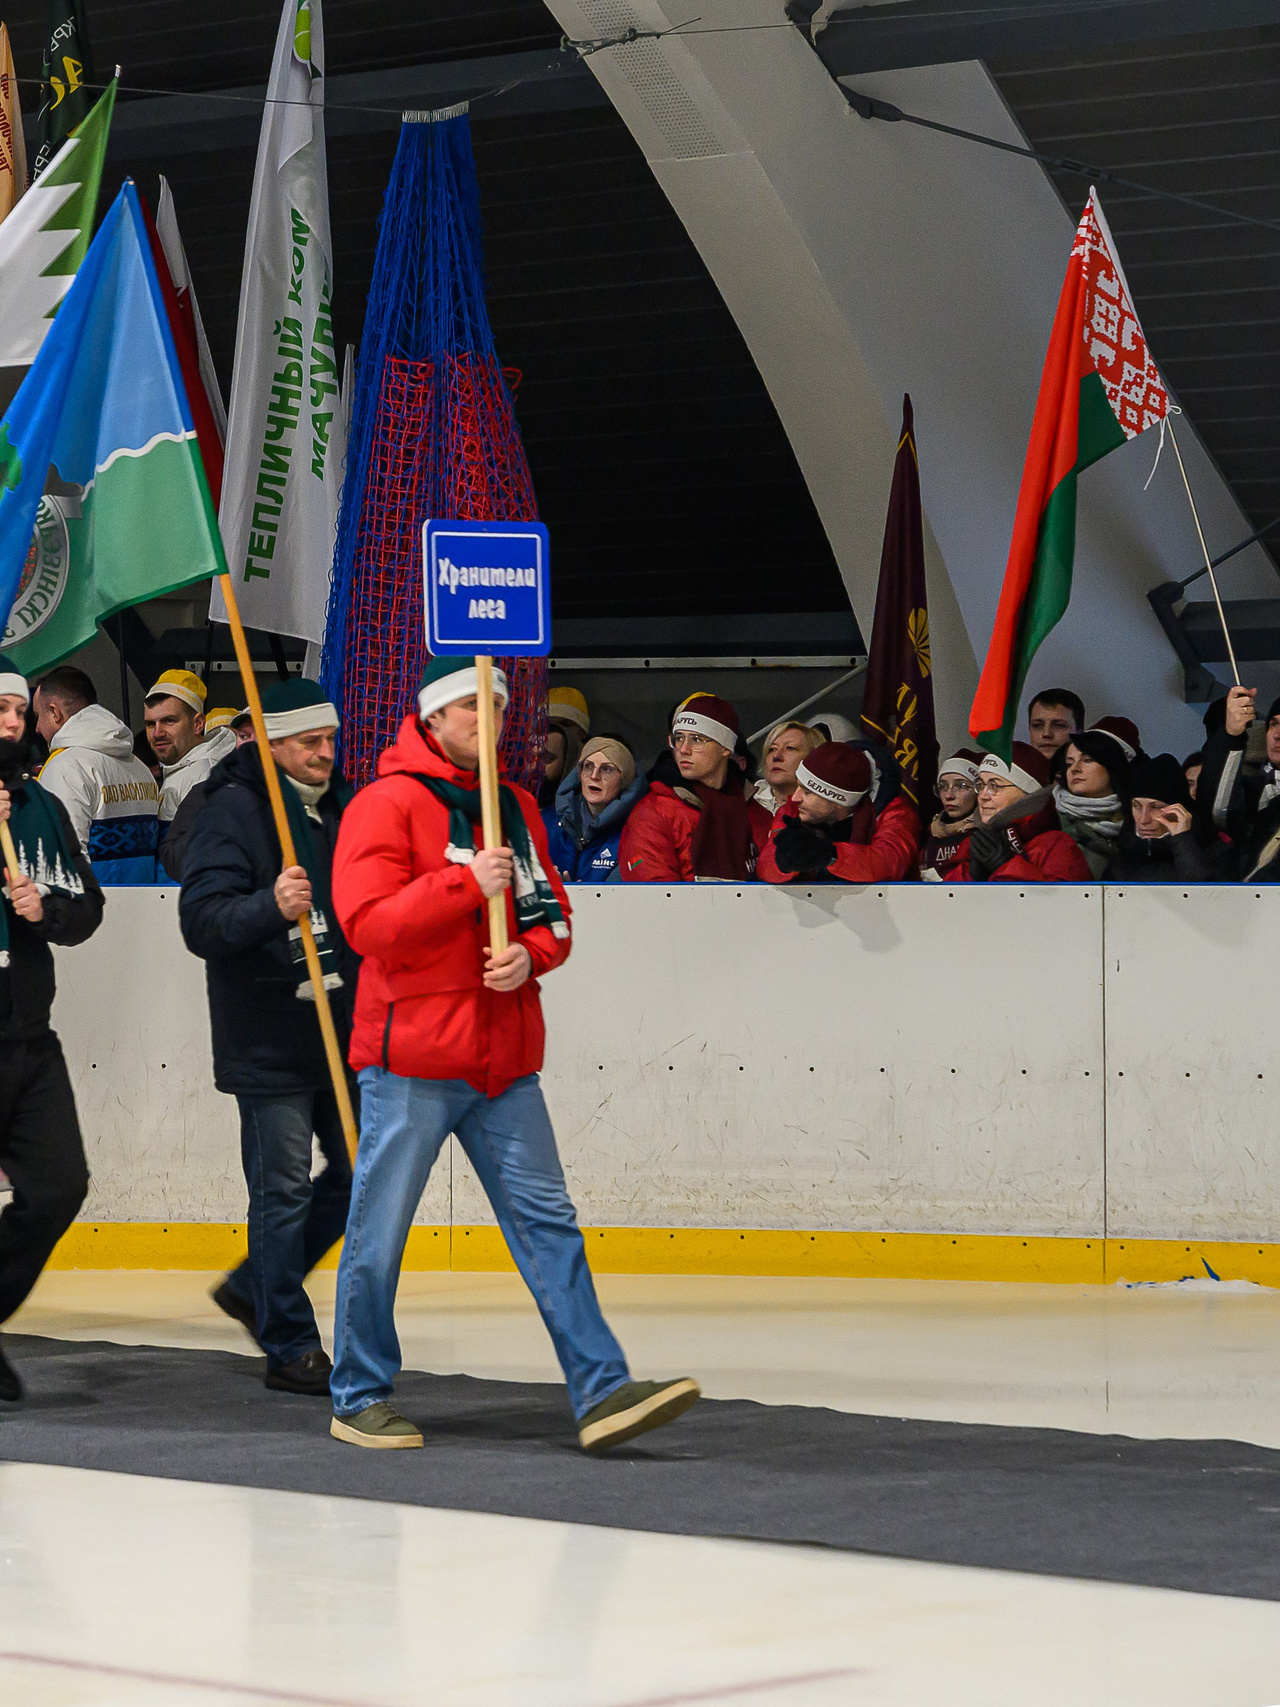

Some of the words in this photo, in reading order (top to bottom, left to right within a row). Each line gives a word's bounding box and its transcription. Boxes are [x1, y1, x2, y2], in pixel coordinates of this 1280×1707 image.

[243, 319, 304, 583] ТЕПЛИЧНЫЙ
[438, 557, 536, 595] Хранители
[468, 599, 506, 620] леса
[806, 779, 847, 802] БЕЛАРУСЬ
